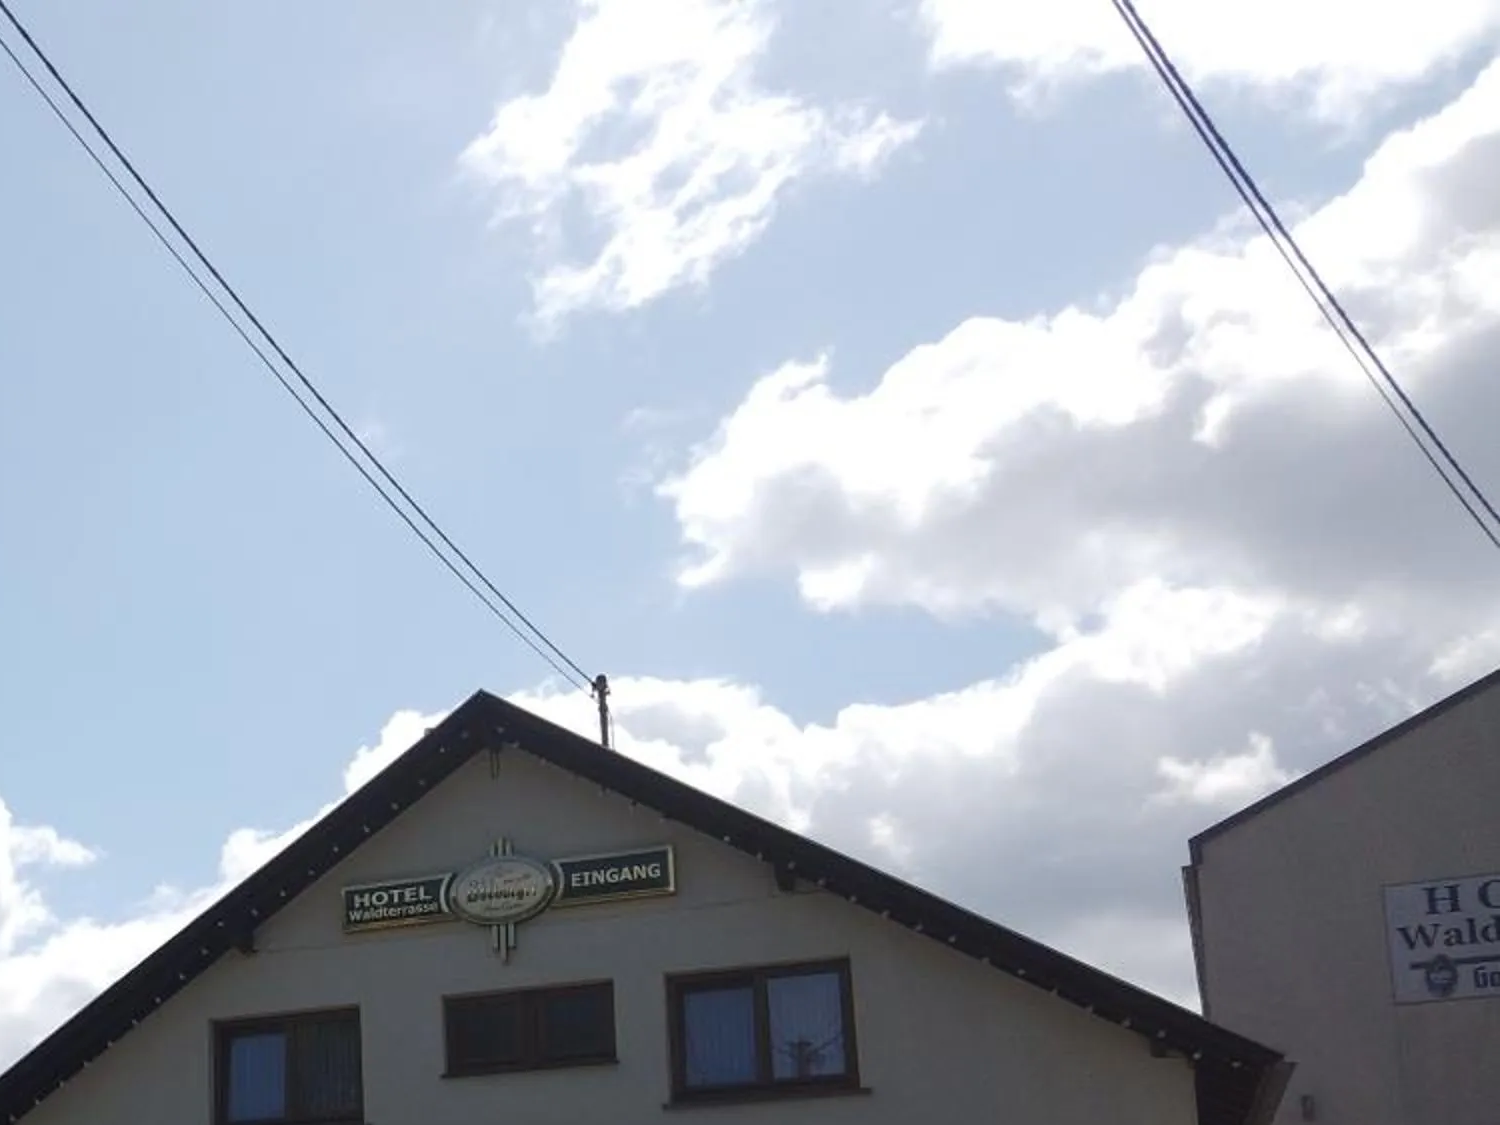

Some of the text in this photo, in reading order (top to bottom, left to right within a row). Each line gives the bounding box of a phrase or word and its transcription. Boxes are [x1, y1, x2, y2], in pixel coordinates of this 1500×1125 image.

[570, 863, 661, 887] EINGANG
[353, 884, 433, 909] HOTEL
[348, 901, 440, 922] Waldterrasse
